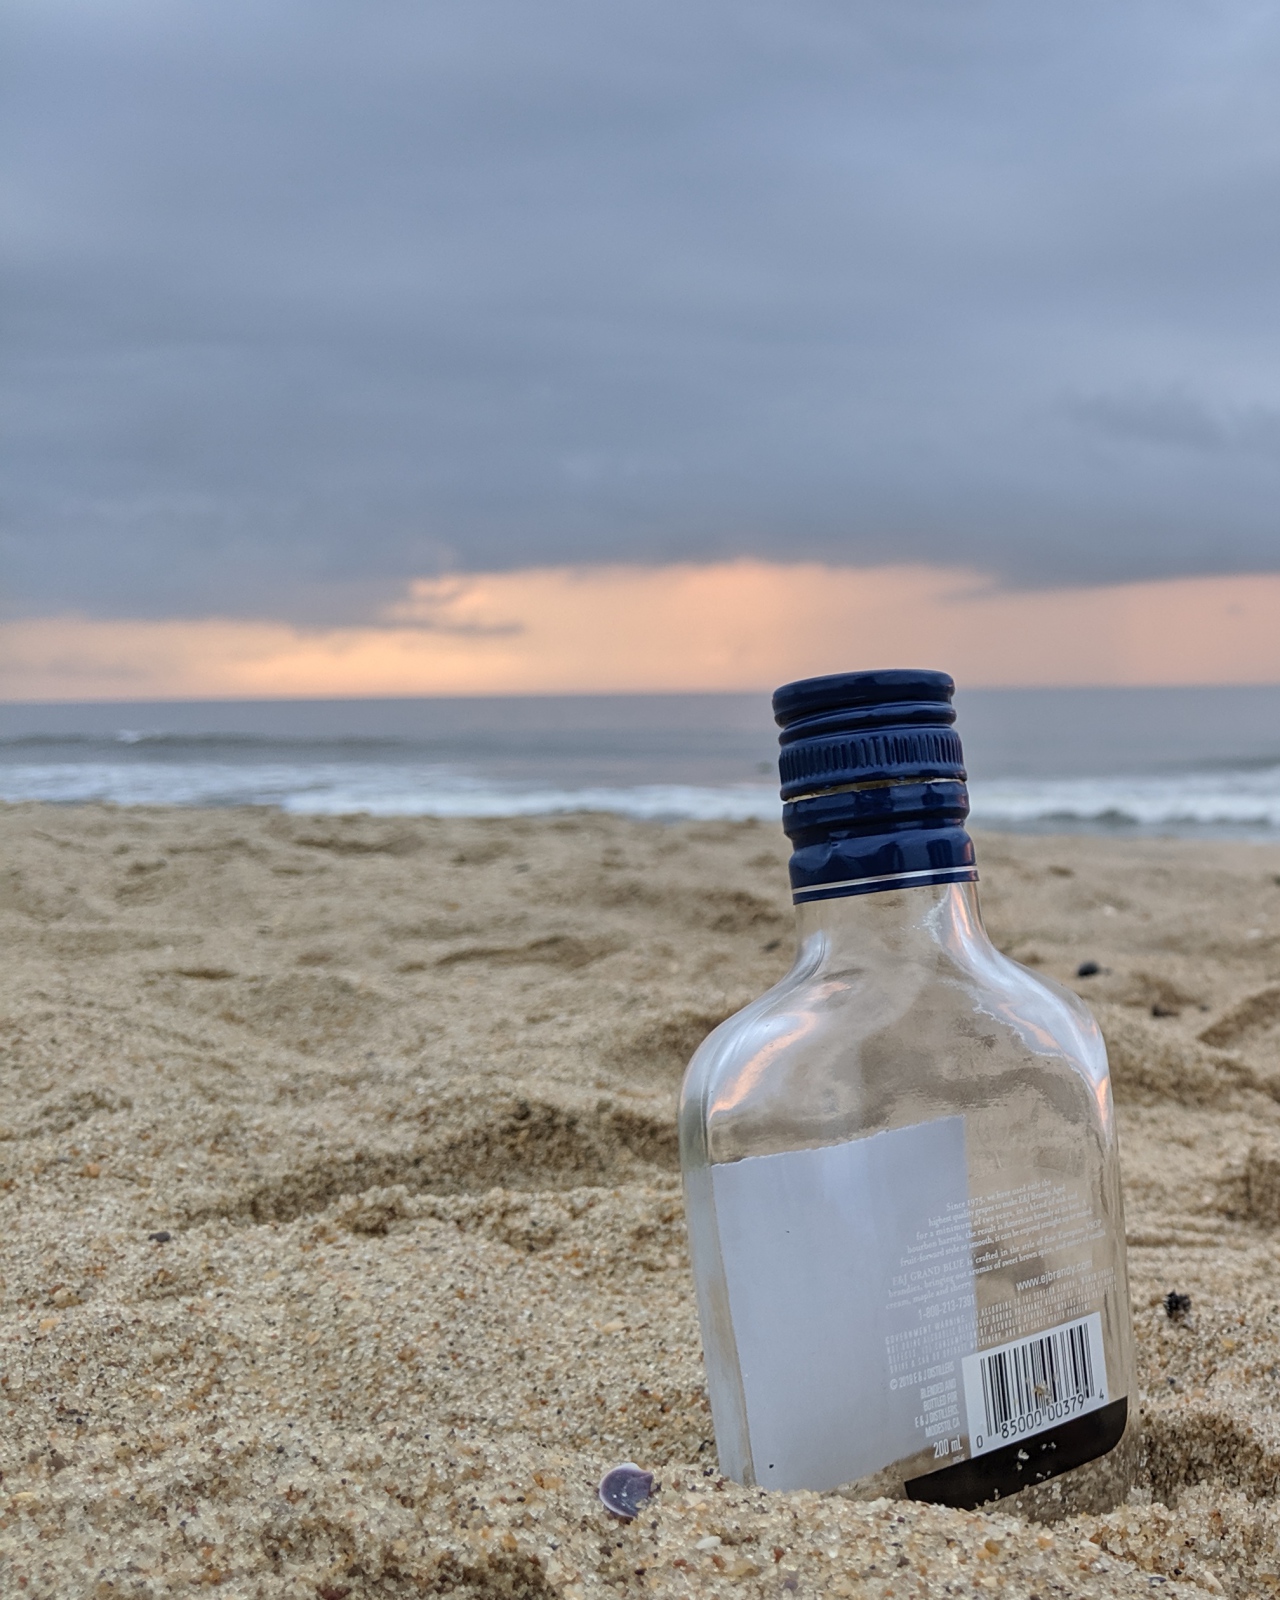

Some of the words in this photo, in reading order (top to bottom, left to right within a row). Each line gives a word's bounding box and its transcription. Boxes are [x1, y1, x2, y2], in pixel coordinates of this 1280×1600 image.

[928, 1216, 952, 1228] highest
[952, 1209, 974, 1223] quality
[946, 1202, 966, 1211] Since
[906, 1241, 937, 1253] bourbon
[965, 1230, 977, 1239] the
[977, 1224, 997, 1235] result
[916, 1231, 928, 1240] for
[935, 1222, 973, 1235] minimum
[973, 1216, 982, 1226] of
[892, 1274, 907, 1286] E&J
[910, 1266, 941, 1281] GRAND
[943, 1259, 965, 1272] BLUE
[975, 1250, 999, 1263] crafted
[1000, 1248, 1009, 1257] in
[1009, 1245, 1020, 1254] the
[1036, 1237, 1043, 1246] of
[900, 1248, 944, 1266] fruit-forward
[945, 1244, 960, 1256] style
[968, 1265, 993, 1276] aromas
[993, 1260, 1001, 1269] of
[1001, 1257, 1018, 1267] sweet
[1018, 1252, 1038, 1261] brown
[1015, 1260, 1093, 1291] www.ejbrandy.com
[912, 1290, 935, 1303] maple
[936, 1285, 949, 1296] and
[885, 1325, 931, 1344] GOVERNMENT
[952, 1417, 961, 1428] CA
[976, 1435, 983, 1448] 0
[1001, 1410, 1042, 1439] 85000
[1048, 1394, 1084, 1421] 00379
[933, 1439, 949, 1458] 200
[951, 1434, 963, 1452] mL
